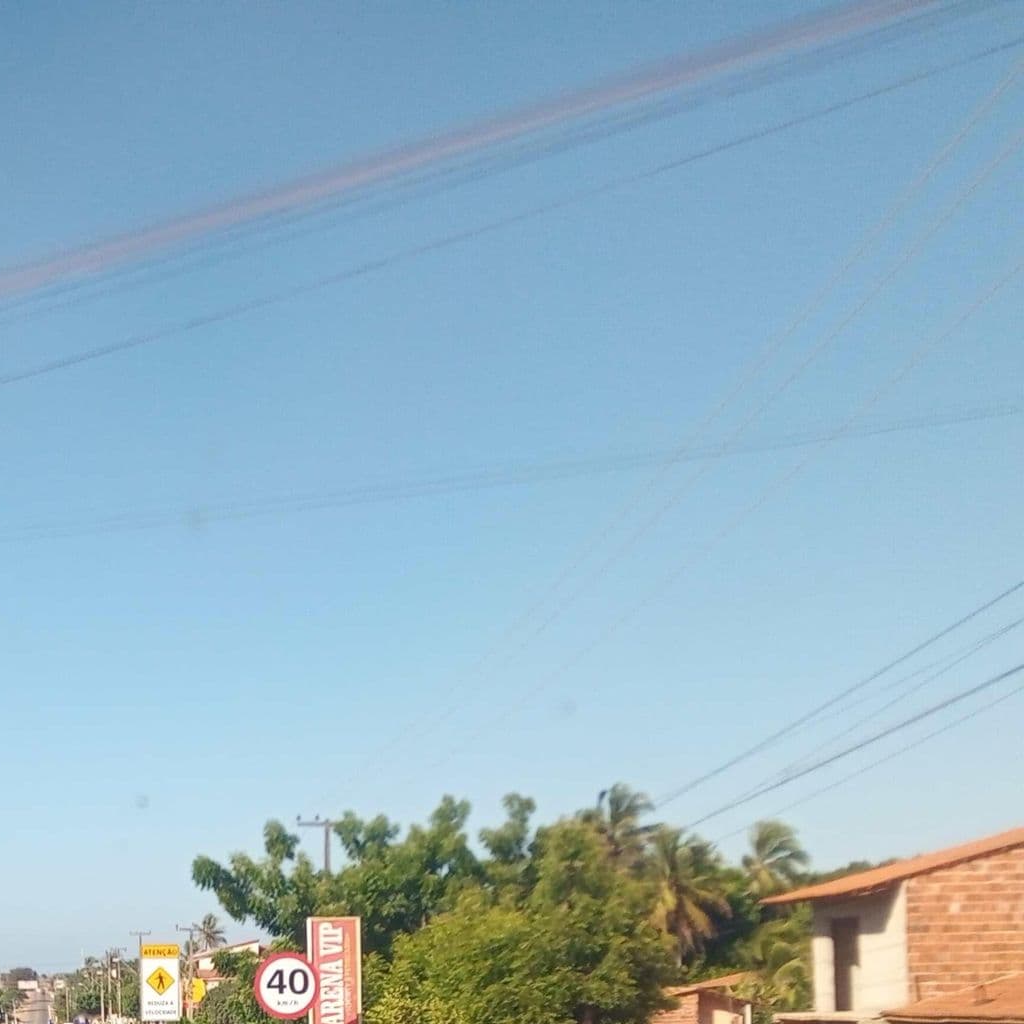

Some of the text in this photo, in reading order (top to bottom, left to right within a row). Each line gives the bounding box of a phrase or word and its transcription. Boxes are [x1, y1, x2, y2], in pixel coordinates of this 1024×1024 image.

[143, 947, 178, 957] ATENÇÃO
[318, 922, 345, 957] VIP
[267, 969, 309, 995] 40
